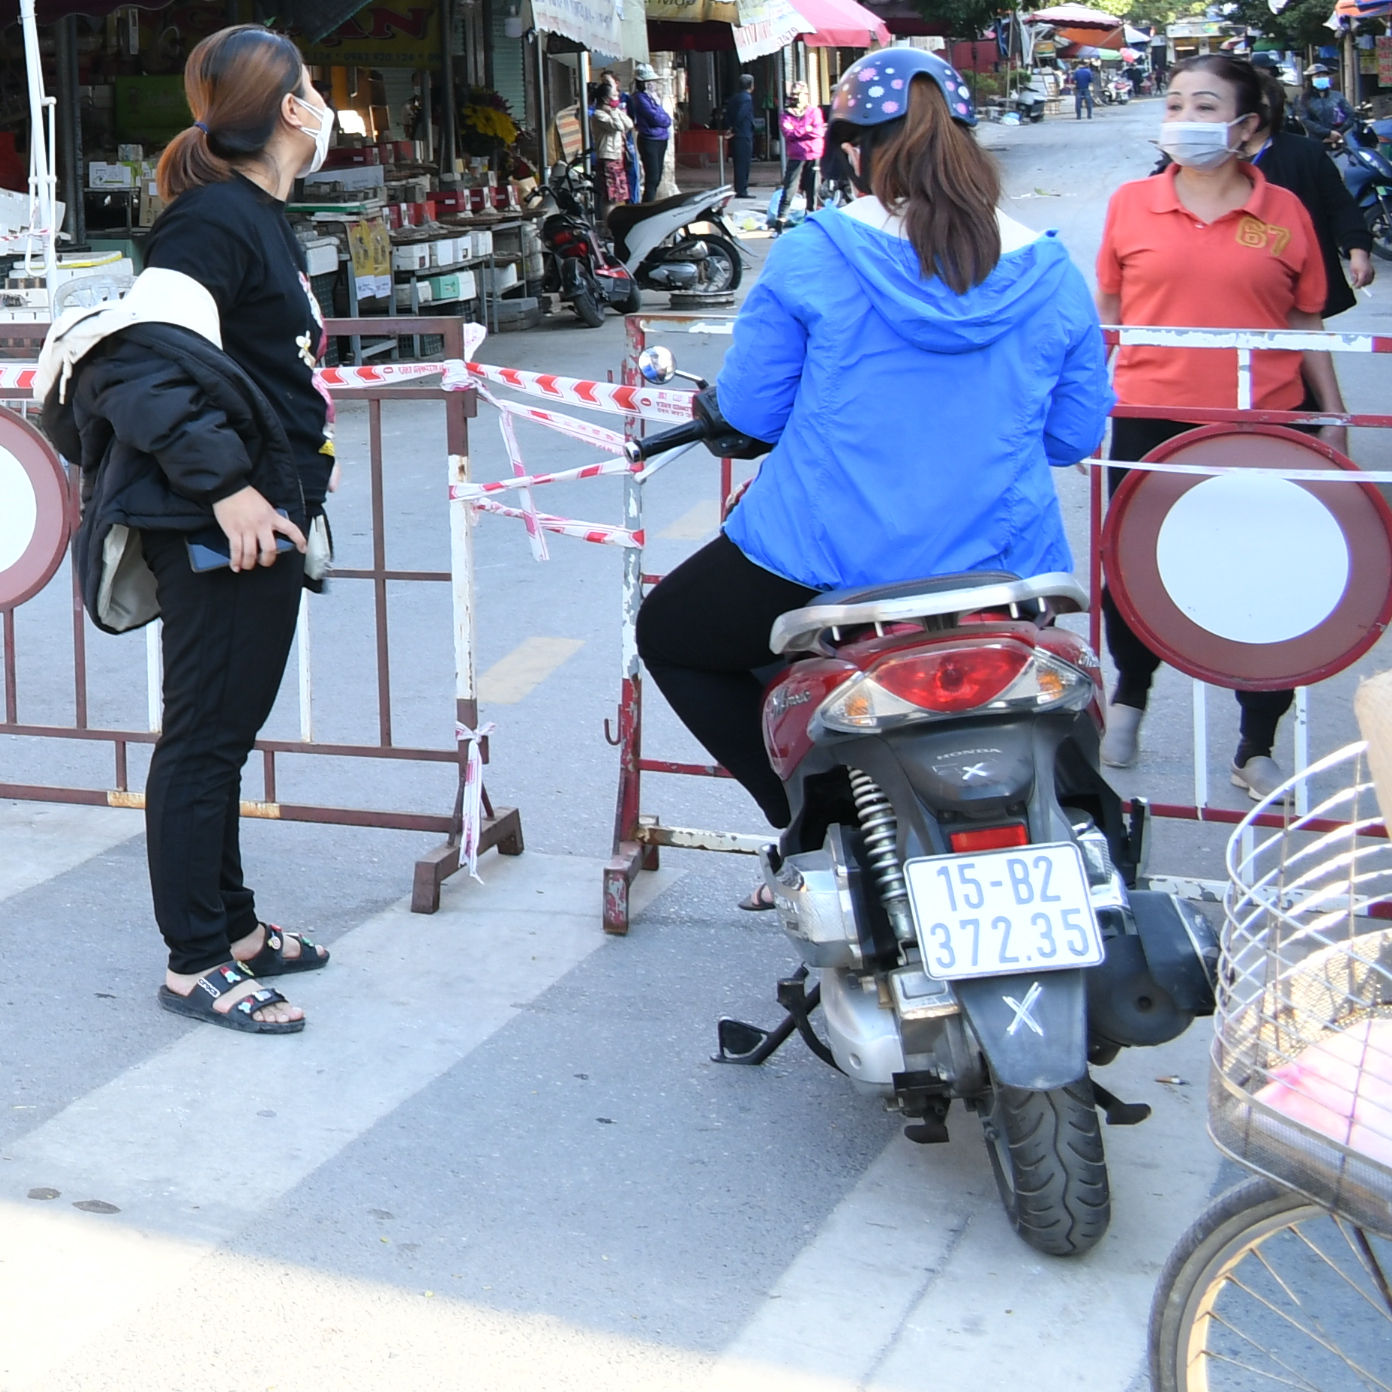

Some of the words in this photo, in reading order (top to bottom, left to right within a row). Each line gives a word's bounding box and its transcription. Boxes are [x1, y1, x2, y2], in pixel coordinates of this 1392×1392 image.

[1235, 216, 1292, 257] 67
[936, 748, 1003, 760] HONDA
[936, 855, 1062, 912] 15-B2
[929, 907, 1090, 969] 372.35
